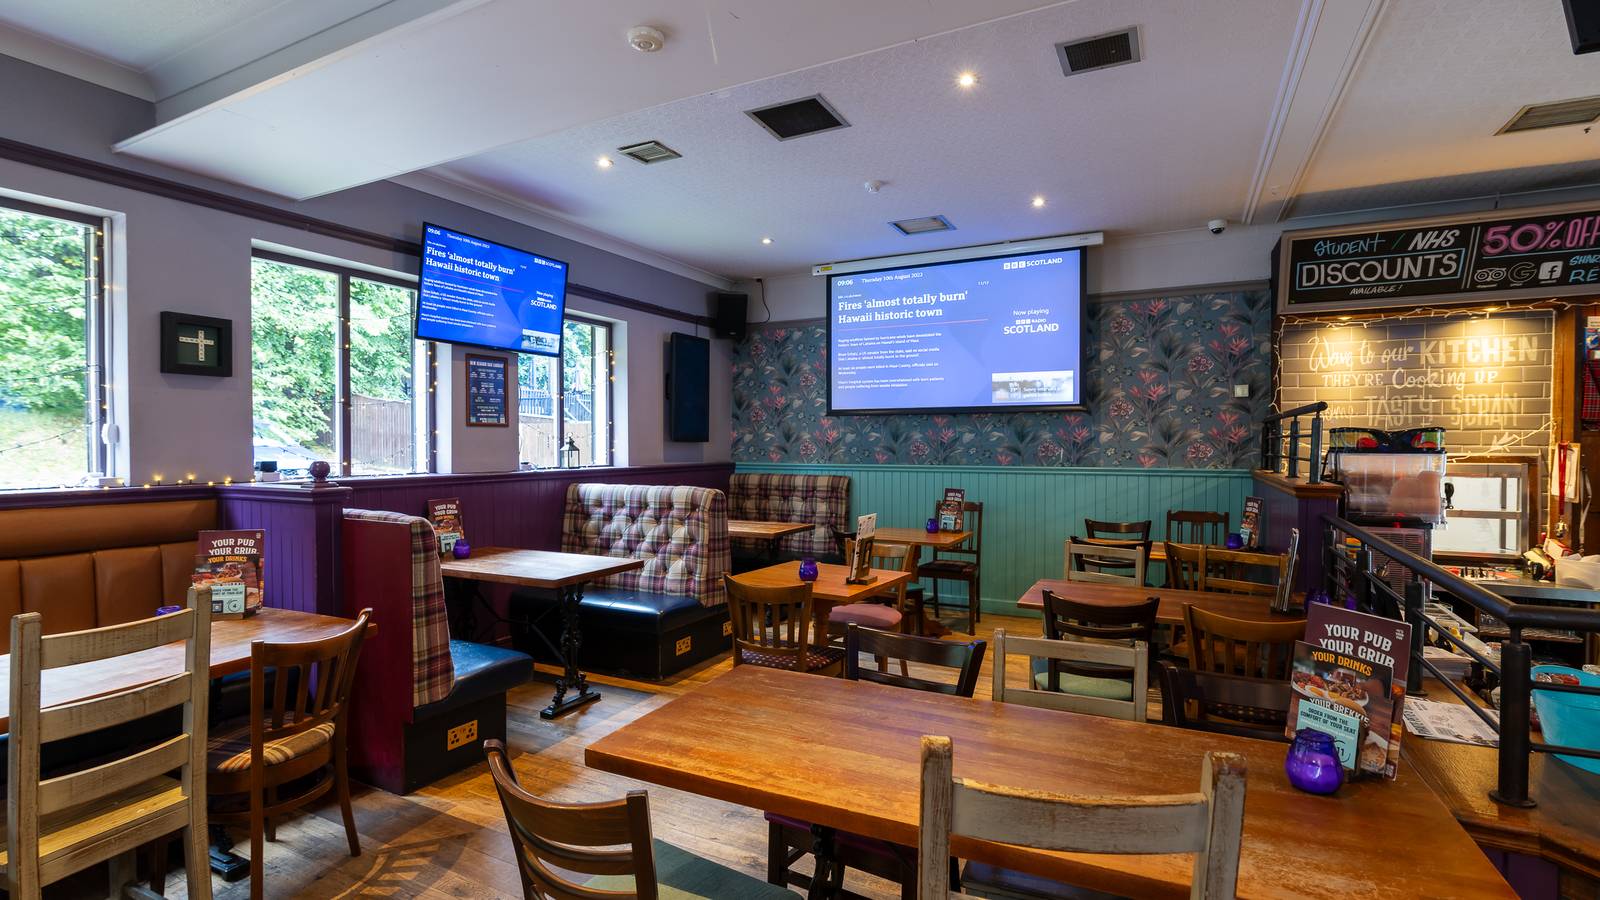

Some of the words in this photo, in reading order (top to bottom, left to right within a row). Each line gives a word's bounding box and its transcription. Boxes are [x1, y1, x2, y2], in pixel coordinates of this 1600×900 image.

[1407, 229, 1461, 251] NHS
[1481, 220, 1566, 256] 50%
[426, 246, 446, 258] Fires
[474, 259, 498, 272] totally
[426, 257, 453, 271] Hawaii
[454, 263, 482, 278] historic
[482, 271, 500, 282] town
[1026, 257, 1063, 267] SCOTLAND
[1301, 253, 1458, 287] DISCOUNTS
[837, 279, 853, 287] 09:06
[861, 277, 882, 285] Thursday
[530, 299, 557, 311] SCOTLAND
[838, 301, 862, 311] Fires
[864, 298, 901, 309] 'almost
[902, 293, 937, 305] totally
[939, 290, 968, 302] burn'
[838, 313, 872, 324] Hawaii
[874, 309, 914, 321] historic
[916, 307, 943, 317] town
[1027, 308, 1050, 316] playing
[1003, 323, 1060, 335] SCOTLAND
[1419, 335, 1538, 366] KITCHEN
[1391, 366, 1466, 390] Cooking
[208, 547, 232, 556] YOUR
[211, 538, 235, 548] YOUR
[237, 538, 255, 547] PUB
[1324, 623, 1360, 641] YOUR
[1364, 630, 1392, 652] PUB
[1319, 638, 1354, 656] YOUR
[1357, 645, 1395, 668] GRUB
[1312, 651, 1335, 664] YOUR
[1337, 655, 1373, 677] DRINKS
[1300, 710, 1322, 723] COMFORT
[1330, 721, 1343, 730] YOUR
[1308, 707, 1323, 717] ORDER
[1323, 712, 1338, 722] FROM
[1339, 717, 1348, 726] THE
